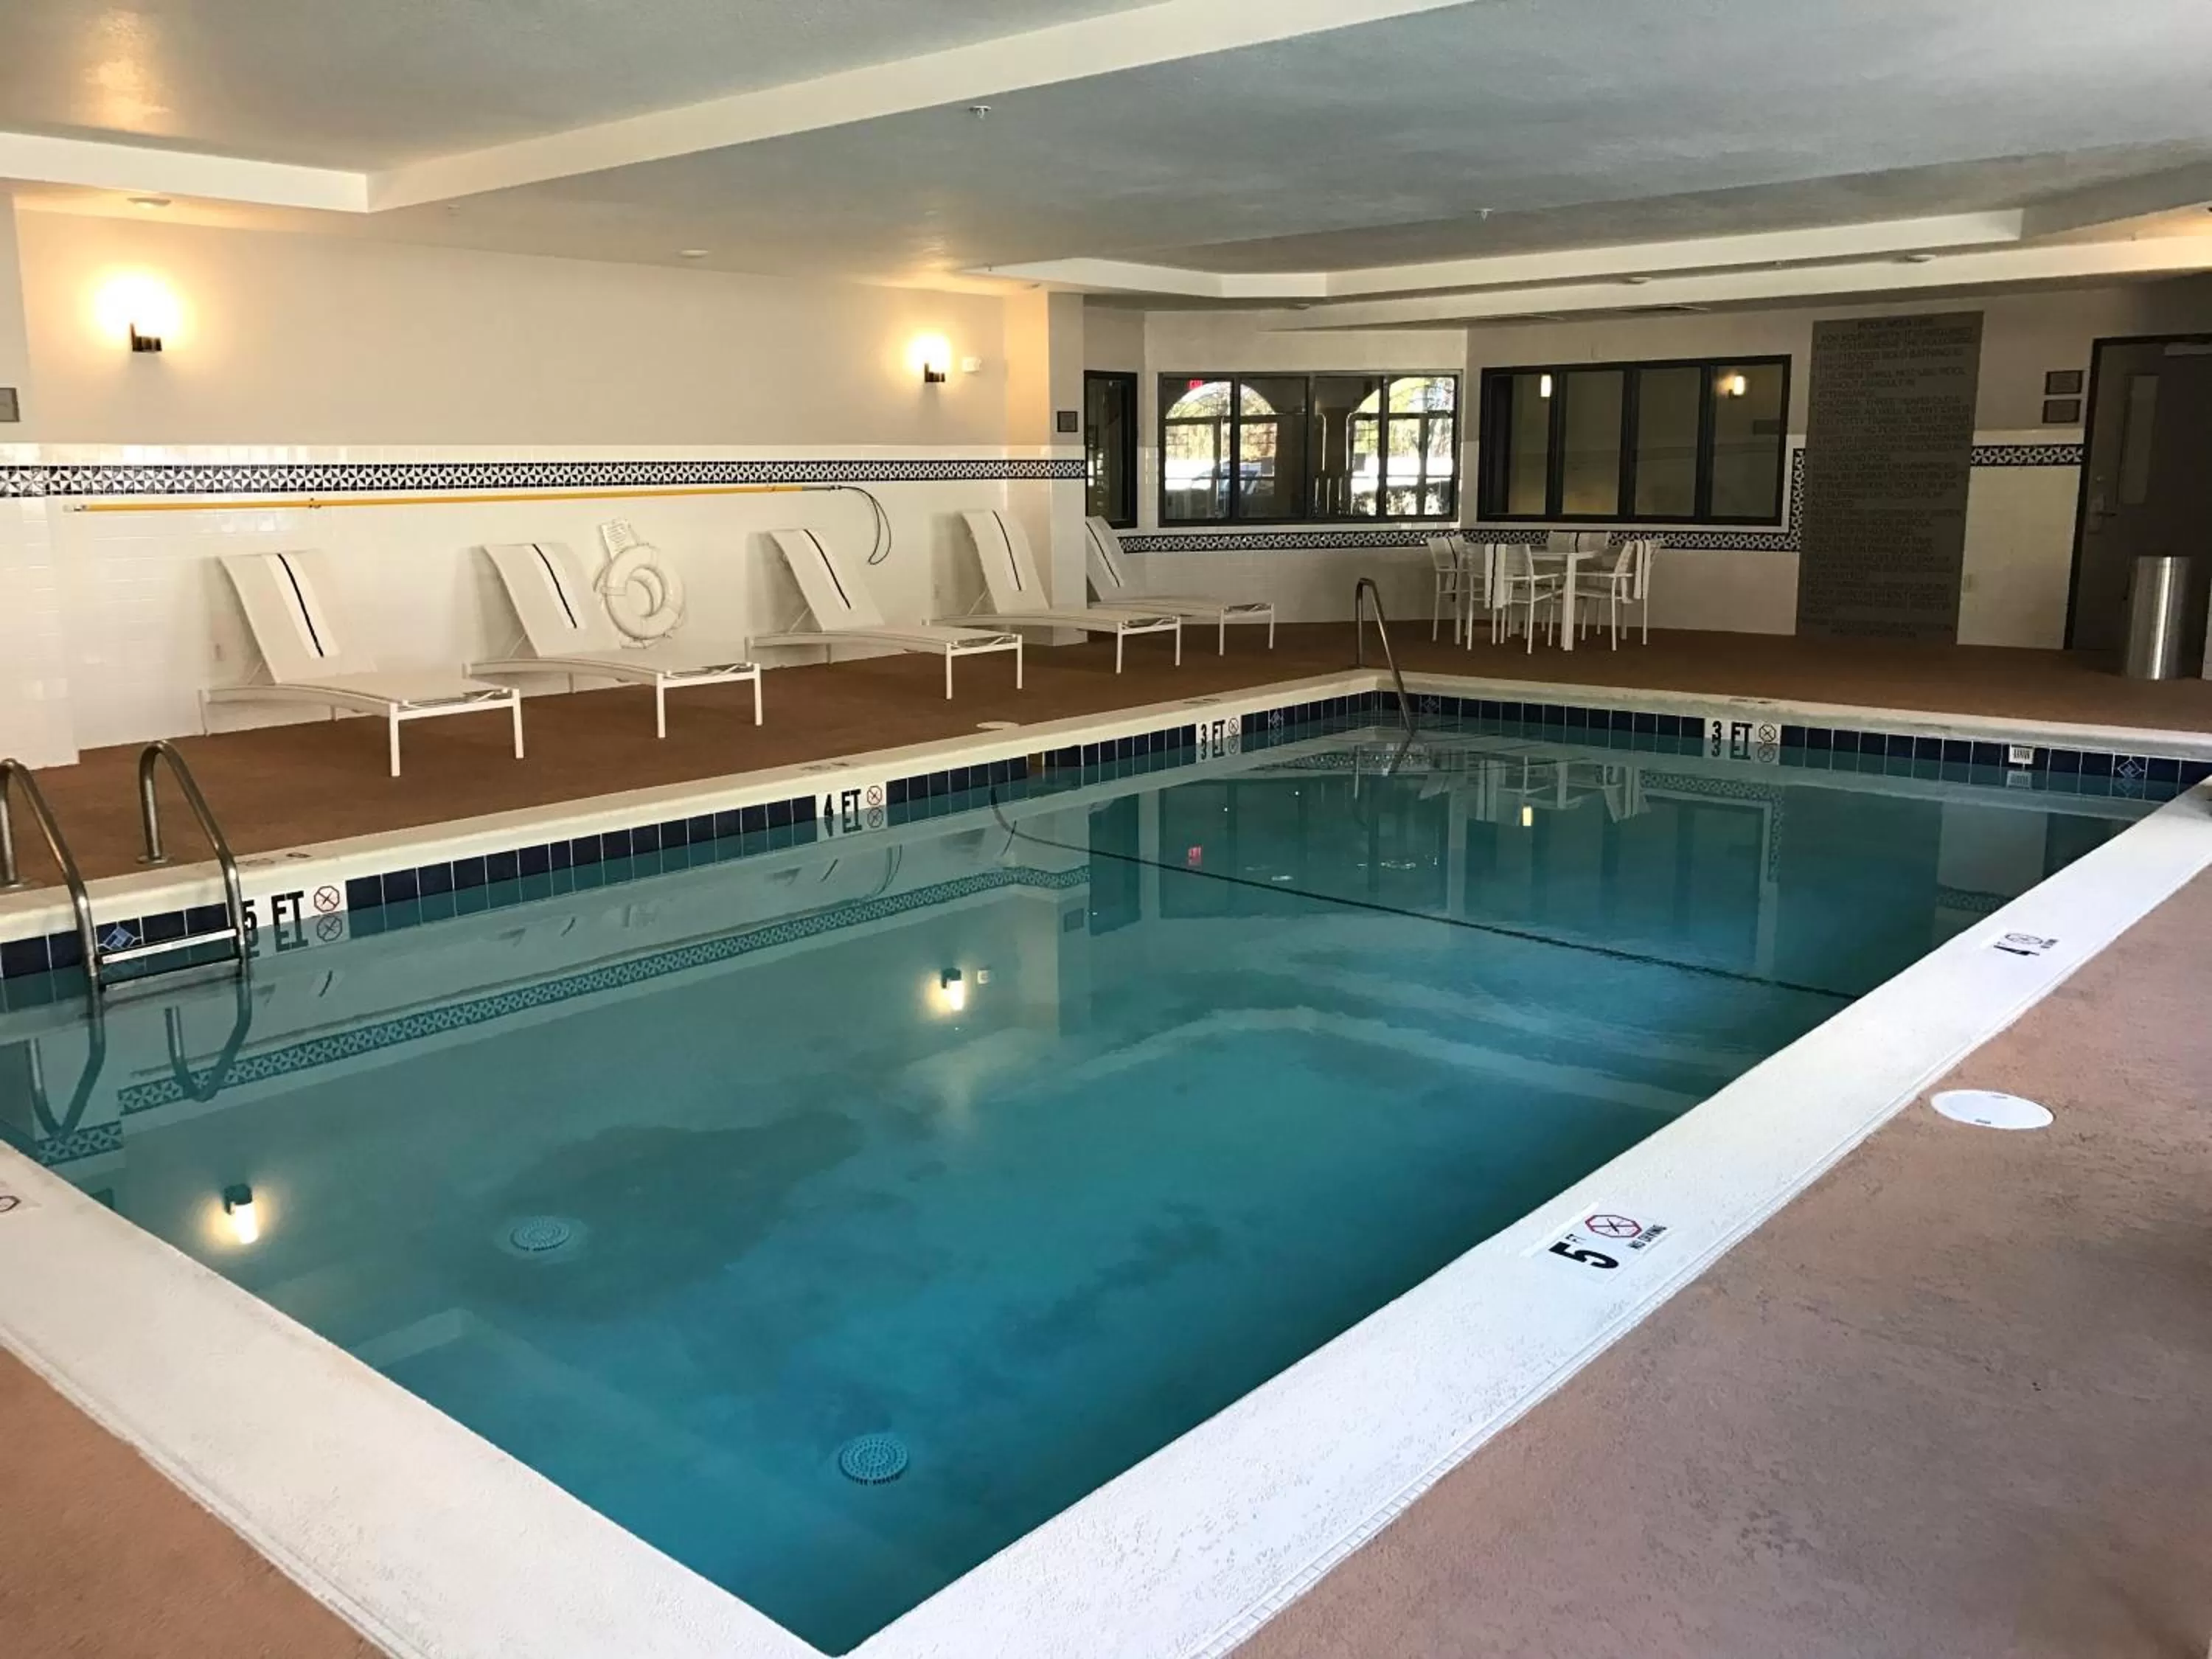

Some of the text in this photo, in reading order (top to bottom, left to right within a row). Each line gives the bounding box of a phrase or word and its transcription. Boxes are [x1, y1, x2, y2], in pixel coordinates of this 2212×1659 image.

[1200, 720, 1225, 742] 3 FT
[1711, 721, 1753, 741] 3 FT
[824, 788, 861, 816] 4 FT
[242, 891, 305, 931] 5 FT
[1548, 1242, 1618, 1269] 5
